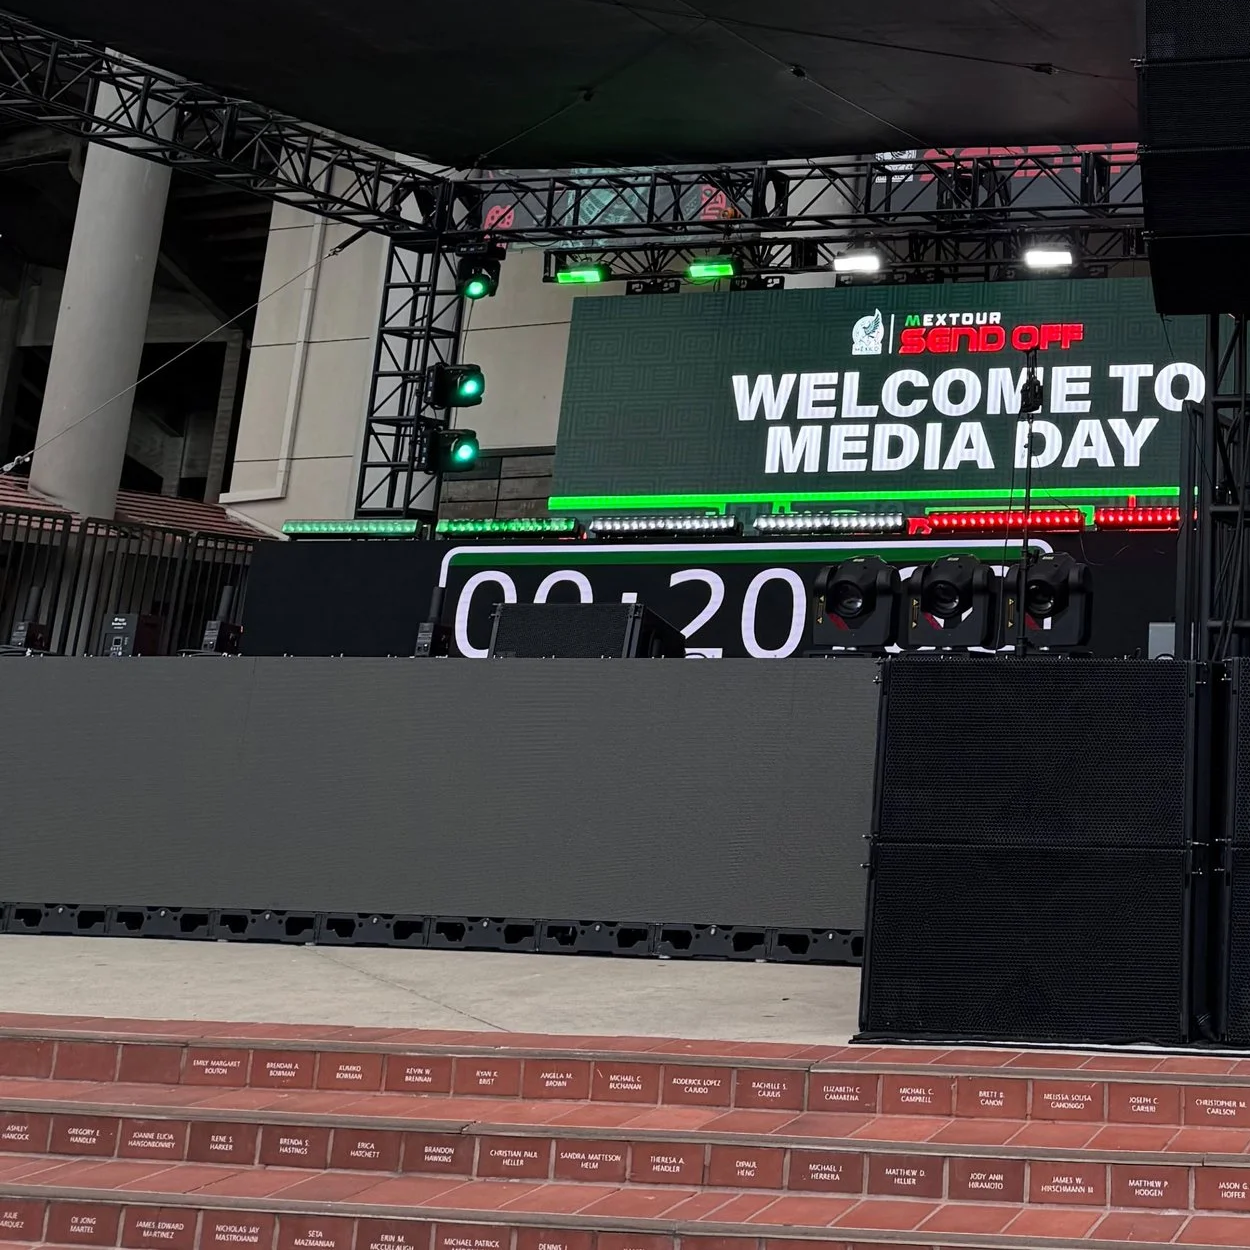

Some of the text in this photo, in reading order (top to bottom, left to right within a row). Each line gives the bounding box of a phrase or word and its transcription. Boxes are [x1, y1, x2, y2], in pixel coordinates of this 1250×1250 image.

[905, 312, 1001, 326] MEXTOUR
[899, 323, 1084, 354] SEND OFF
[732, 363, 1206, 421] WELCOME TO
[764, 418, 1159, 474] MEDIA DAY
[215, 1225, 260, 1234] NICHOLAS JAY
